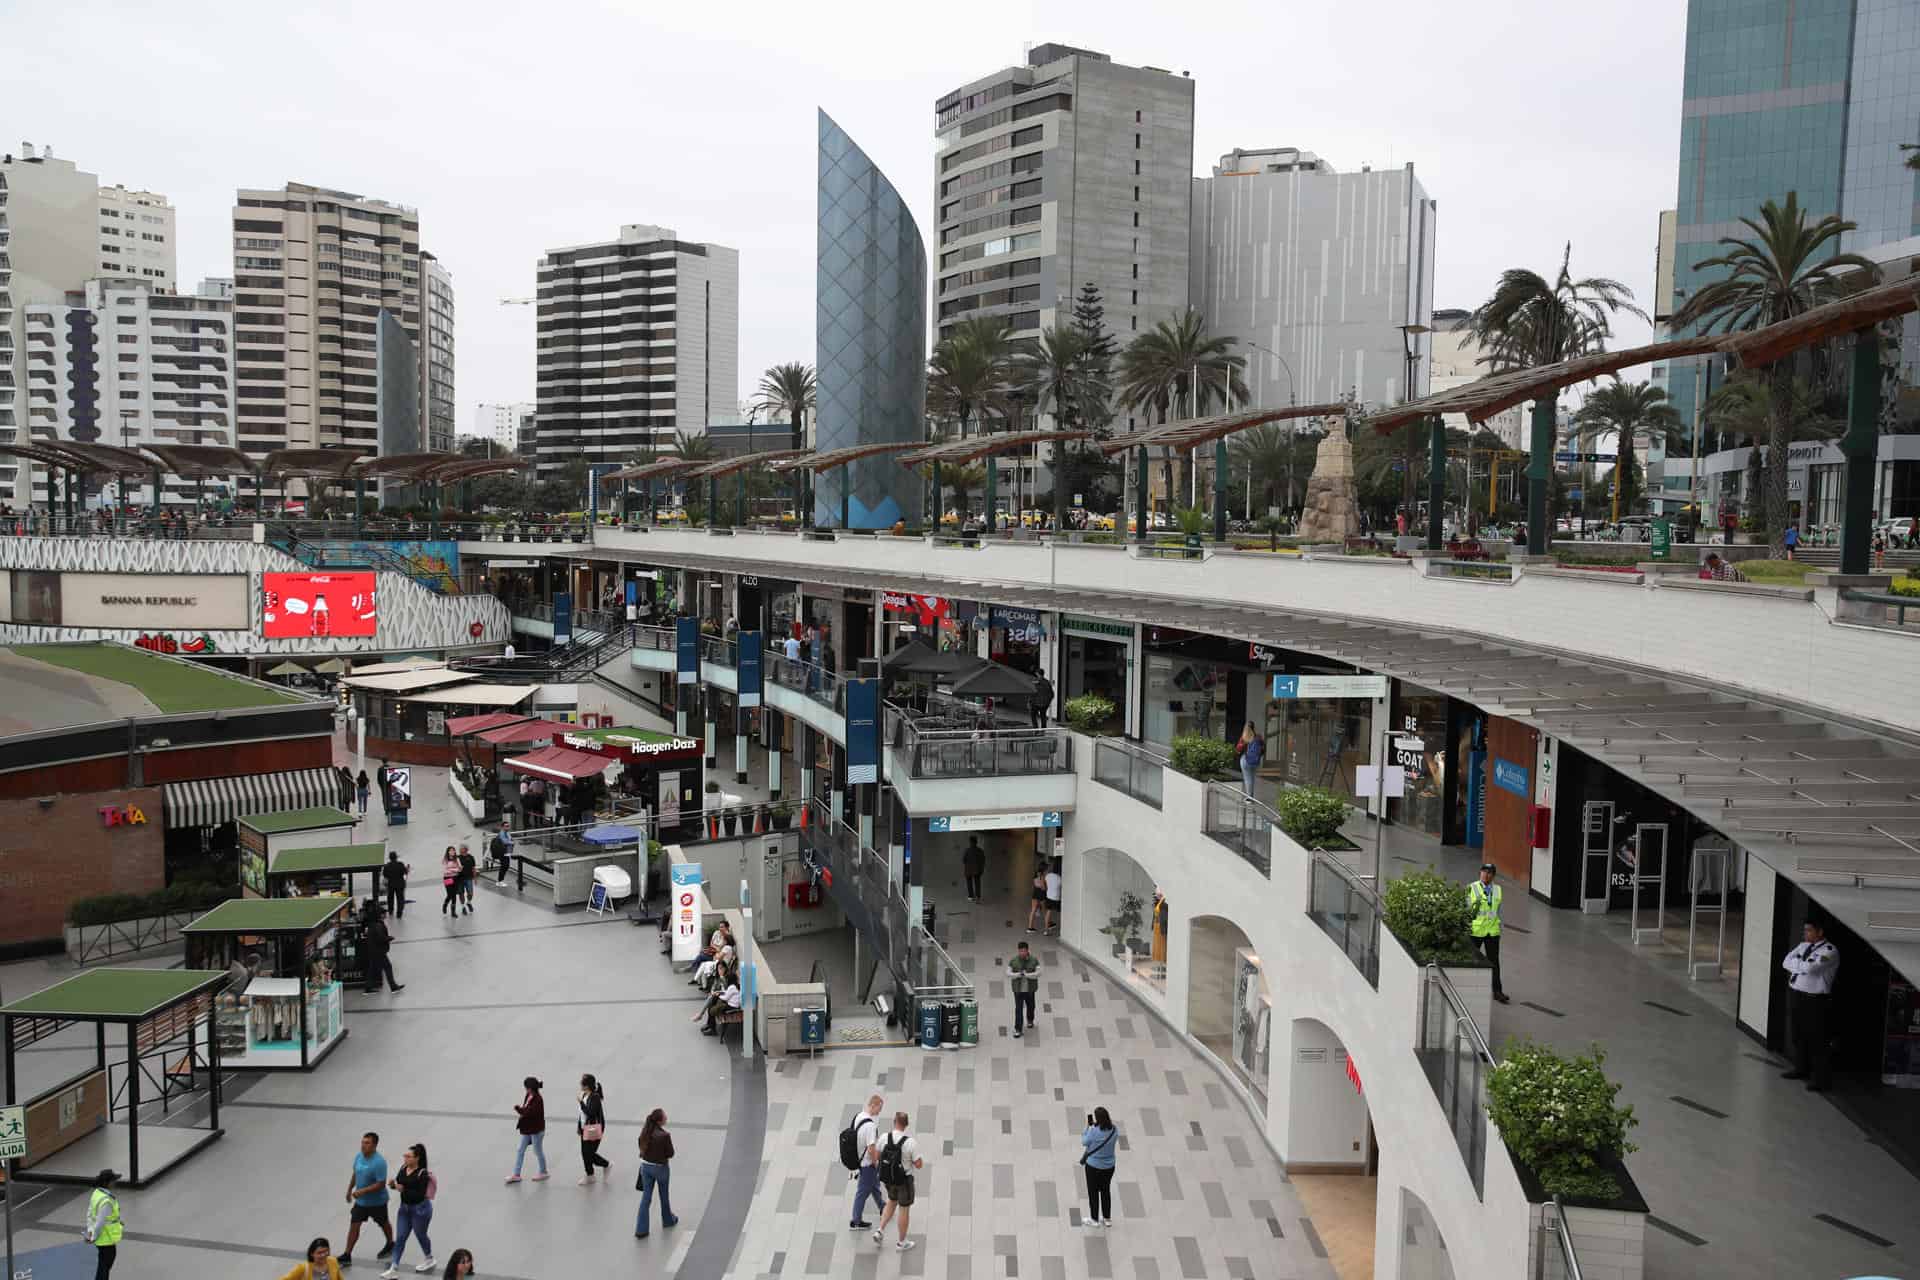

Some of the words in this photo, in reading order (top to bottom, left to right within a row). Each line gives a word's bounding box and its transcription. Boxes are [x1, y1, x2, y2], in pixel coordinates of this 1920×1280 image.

[101, 595, 142, 605] BANANA
[146, 596, 197, 606] REPUBLIC
[1280, 680, 1294, 693] -1
[1405, 715, 1417, 731] BE
[632, 738, 697, 755] Häagen-Dazs
[1397, 750, 1423, 769] GOAT
[933, 817, 948, 828] -2
[1044, 812, 1059, 823] -2
